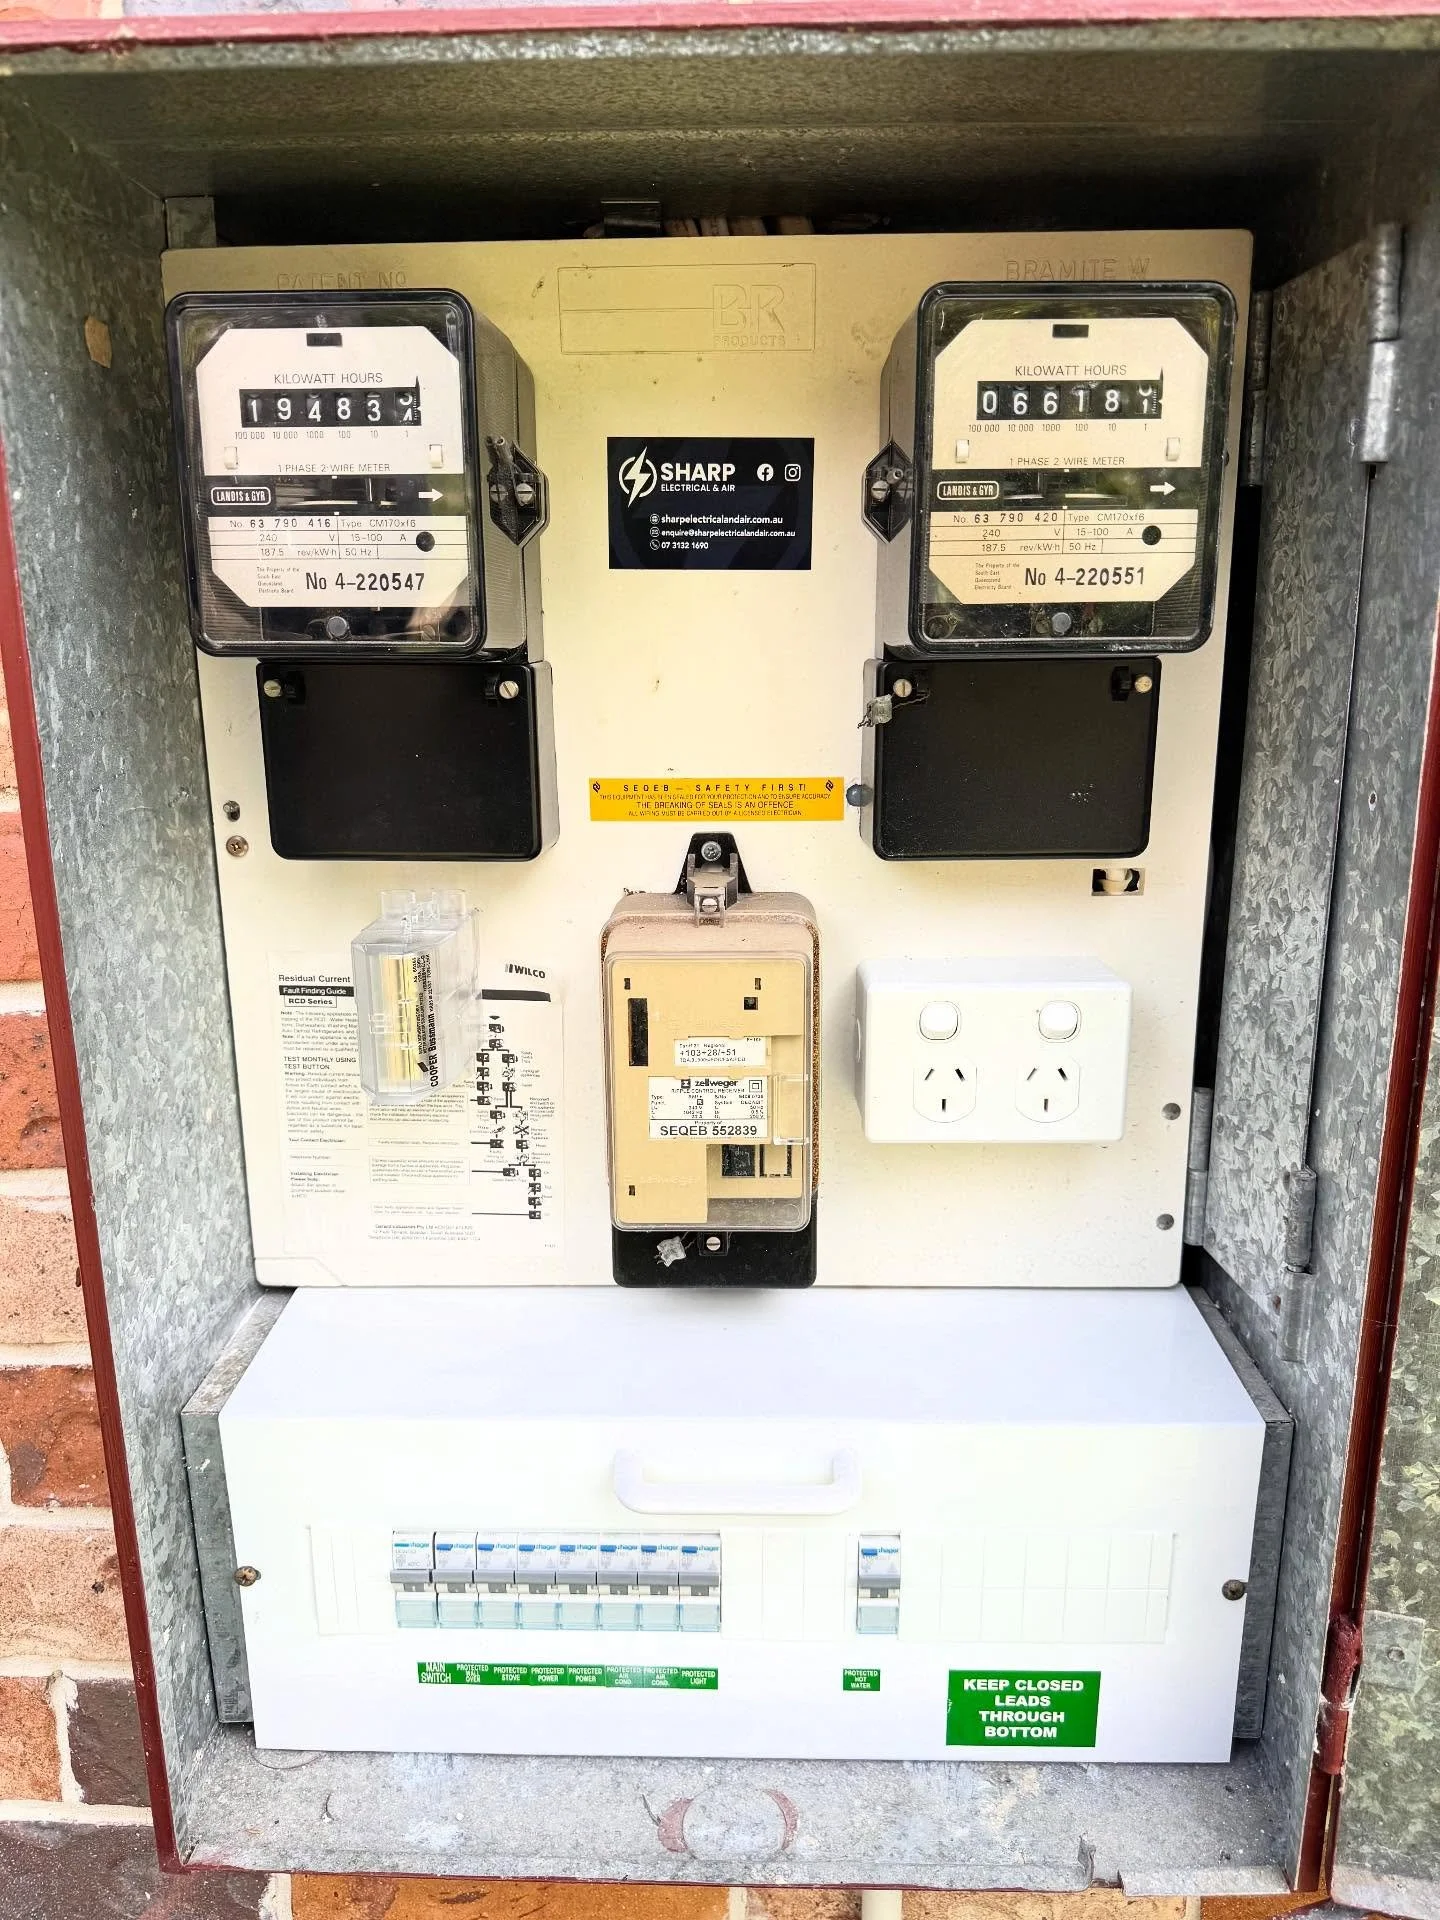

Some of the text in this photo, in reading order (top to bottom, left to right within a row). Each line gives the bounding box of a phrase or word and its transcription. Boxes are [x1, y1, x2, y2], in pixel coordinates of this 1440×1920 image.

[1015, 365, 1126, 376] KILOWATT HOURS
[274, 373, 382, 384] KILOWATT HOURS
[1075, 423, 1088, 432] 100
[1109, 423, 1116, 431] 10
[1064, 457, 1088, 465] WIRE
[1093, 457, 1125, 465] METER
[286, 464, 316, 472] PHASE
[331, 464, 354, 472] WIRE
[661, 463, 735, 482] SHARP
[661, 484, 735, 492] ELECTRICAL & AIR
[943, 485, 993, 496] LANDIS & GYR
[216, 490, 266, 501] LANDIS & GYR
[661, 515, 783, 524] sharpelectricalandair.com.au
[975, 514, 989, 523] 63
[1000, 513, 1023, 522] 790
[1035, 513, 1058, 521] 420
[1068, 513, 1144, 522] Type CM170xf6
[250, 520, 265, 528] 63
[275, 519, 297, 527] 790
[309, 519, 331, 527] 416
[342, 520, 361, 529] Type
[662, 529, 795, 537] enquire@sharpelectricalandair.com.au
[982, 528, 1060, 537] 240 V
[1077, 528, 1133, 536] 15-100 A
[260, 533, 335, 542] 240 V
[351, 533, 406, 542] 15-100 A
[982, 544, 1006, 552] 187.5
[1070, 543, 1096, 551] 50 Hz
[261, 548, 284, 556] 187.5
[346, 548, 371, 556] 50 Hz
[306, 572, 424, 590] No 4-220547
[1025, 567, 1144, 586] No 4-220551
[514, 964, 546, 979] WILCO
[429, 1054, 438, 1087] COOPER
[695, 1079, 738, 1088] zellweger
[660, 1126, 757, 1135] SEQEB 552839
[426, 1662, 445, 1672] MAIN
[421, 1673, 451, 1683] SWITCH
[963, 1679, 1084, 1692] KEEP CLOSED
[995, 1695, 1051, 1707] LEADS
[979, 1711, 1065, 1722] THROUGH
[984, 1726, 1057, 1738] BOTTOM
